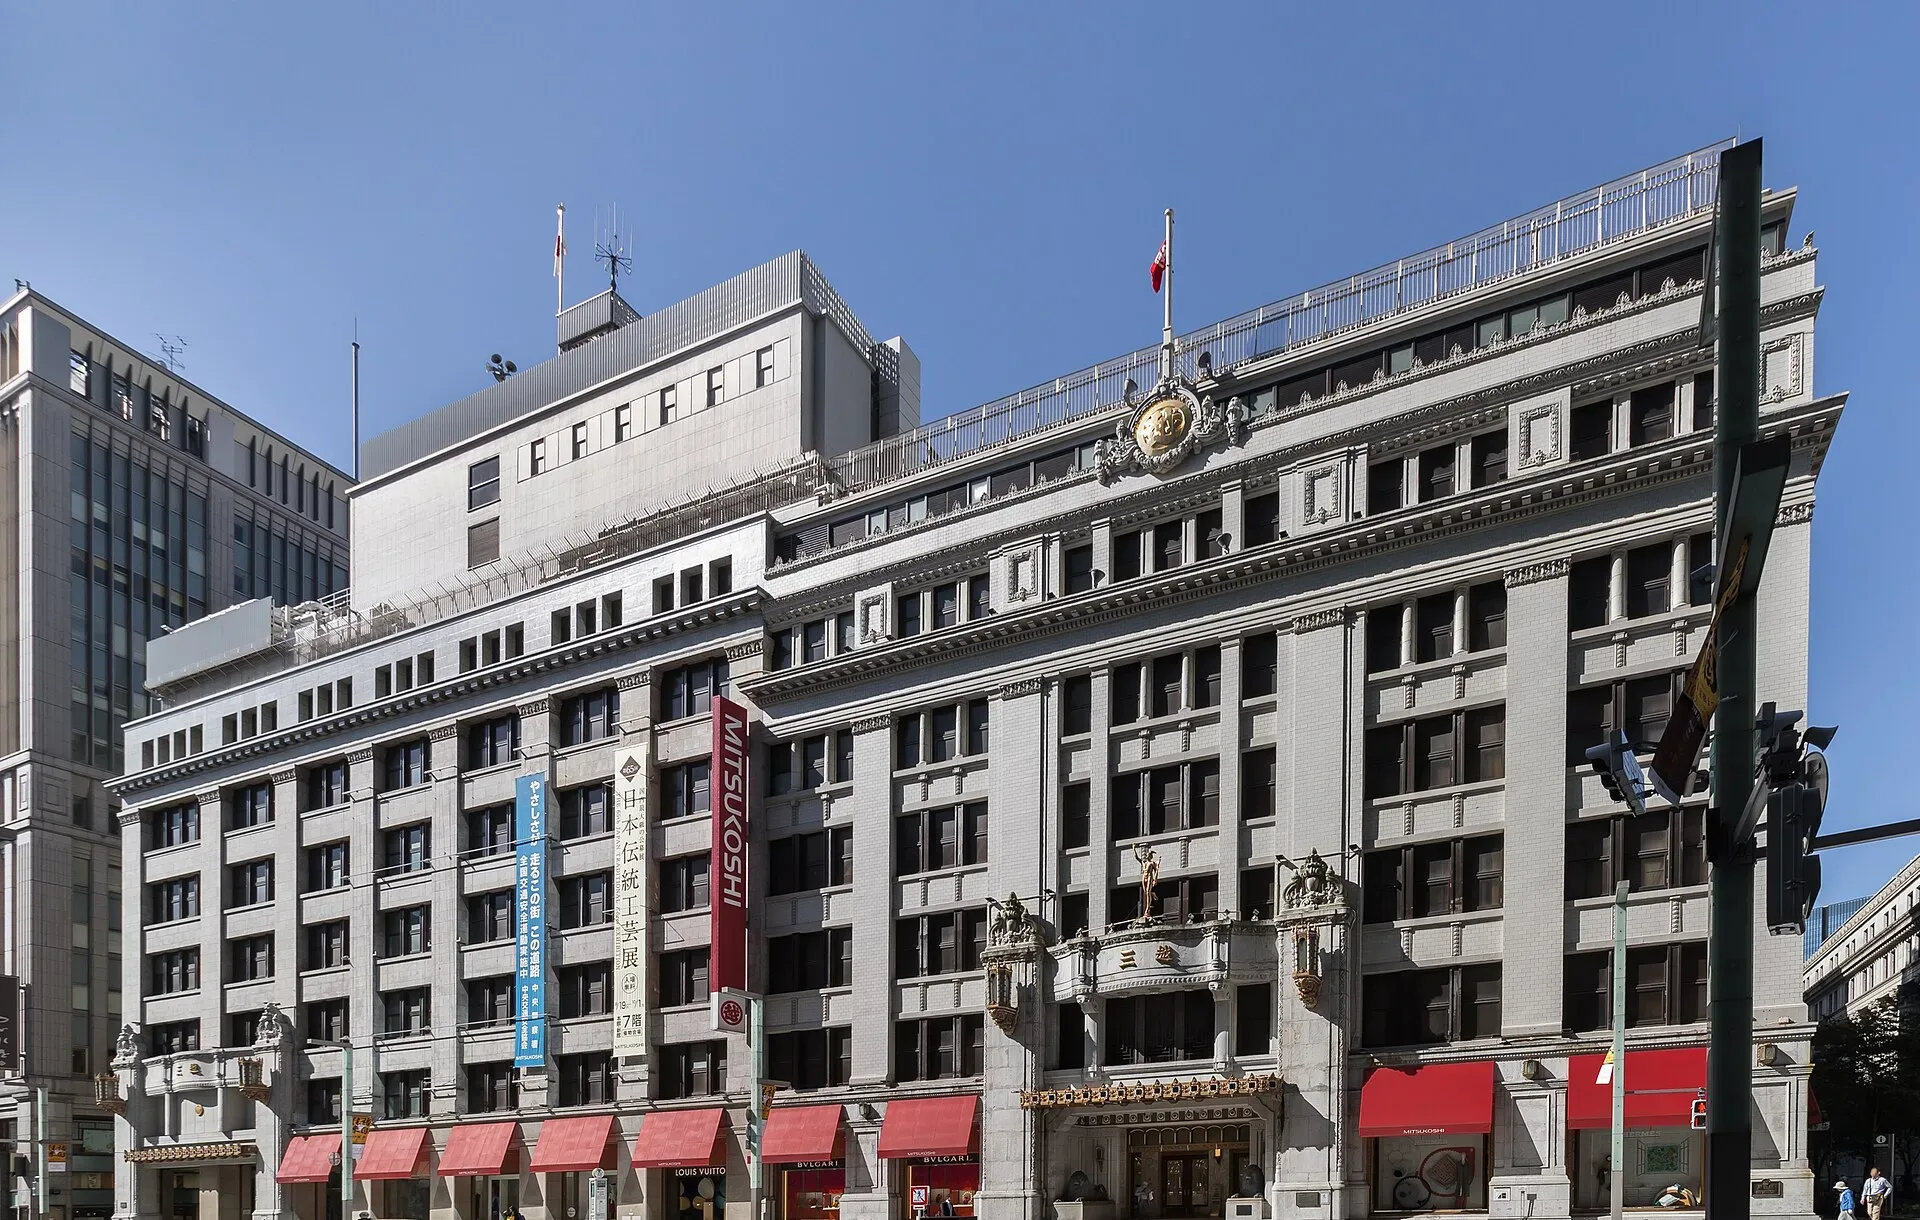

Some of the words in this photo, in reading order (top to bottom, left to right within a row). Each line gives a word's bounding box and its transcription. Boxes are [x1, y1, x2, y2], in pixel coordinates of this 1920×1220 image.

[530, 780, 541, 847] やさしさが
[724, 713, 743, 908] MITSUKOSHI
[530, 852, 541, 919] 走るこの街
[621, 788, 640, 970] 日本伝統工芸展
[519, 855, 529, 979] 全国交通安全運動実施中
[530, 925, 541, 978] この道路
[675, 1168, 697, 1176] LOUIS
[699, 1167, 726, 1175] VUITTO
[797, 1160, 838, 1168] BVLGARI
[923, 1155, 969, 1163] BVLGARI
